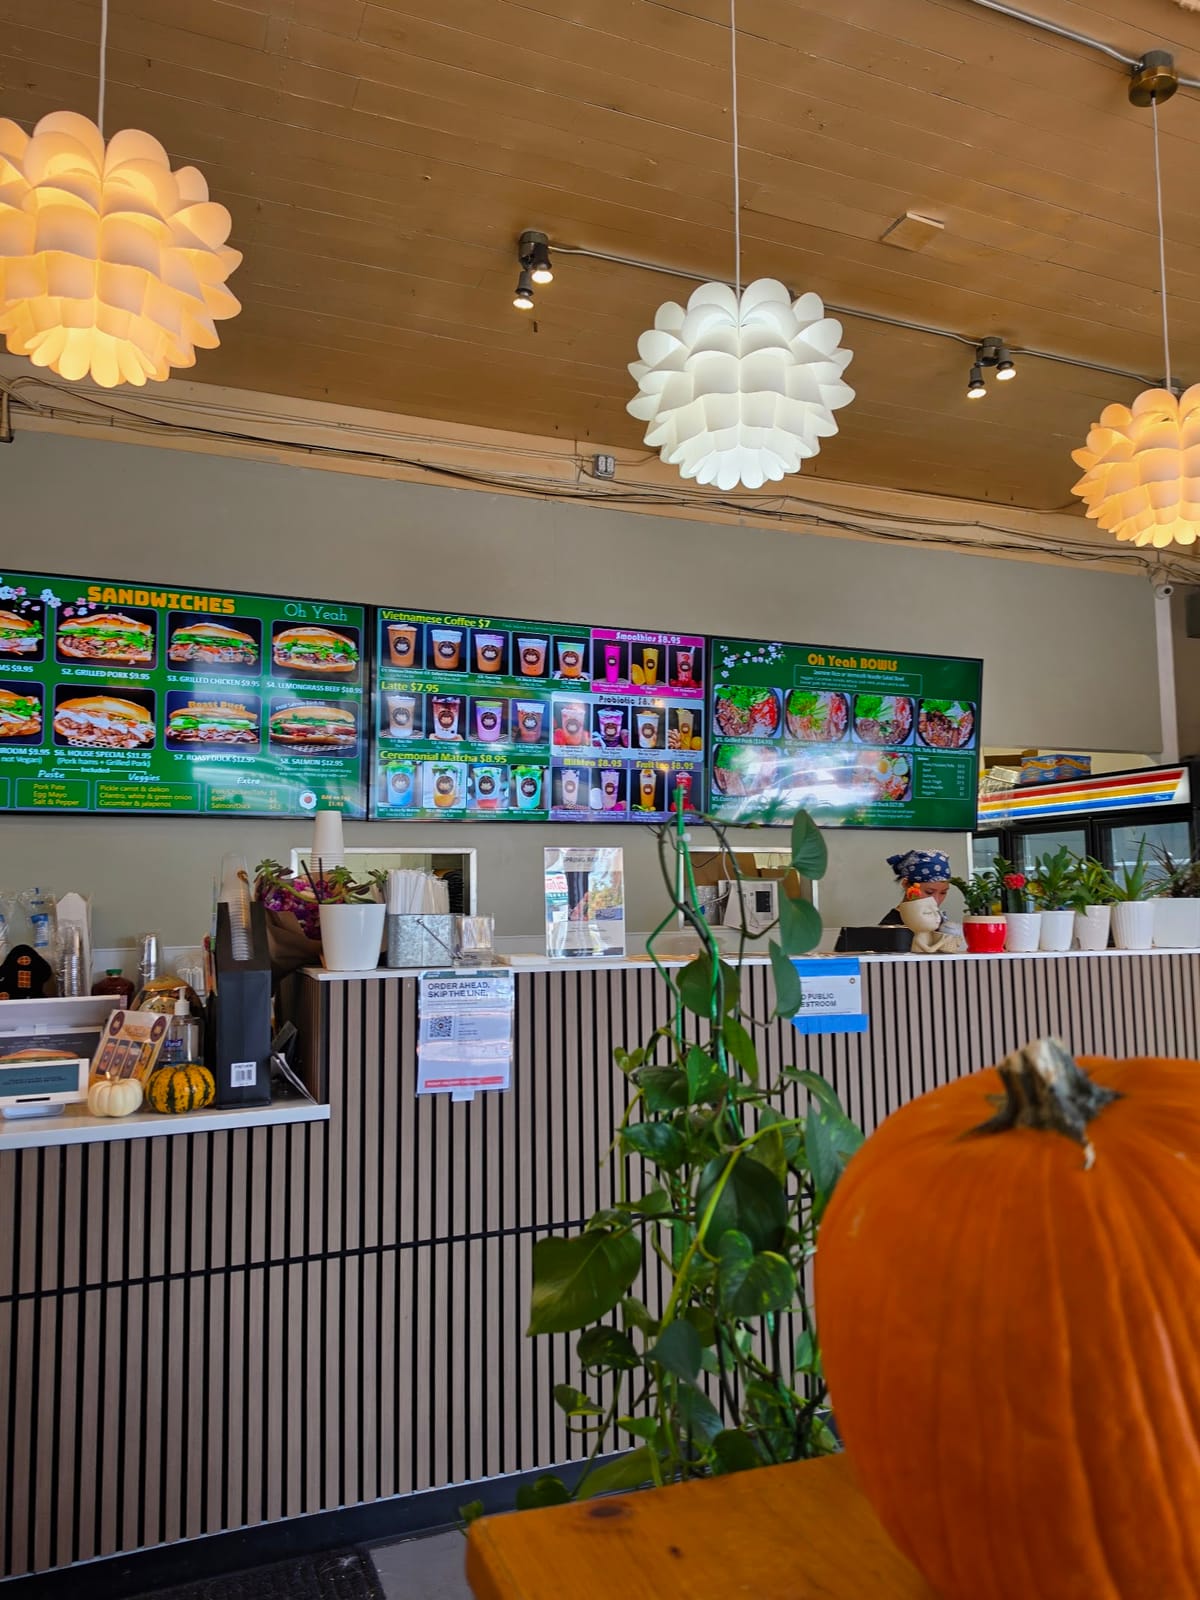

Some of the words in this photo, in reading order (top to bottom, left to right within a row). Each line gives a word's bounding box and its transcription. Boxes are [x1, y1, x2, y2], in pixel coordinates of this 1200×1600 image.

[88, 586, 235, 614] SANDWICHES
[284, 603, 306, 618] Oh
[312, 606, 348, 622] Yeah
[382, 610, 442, 625] Vietnamese
[444, 616, 477, 628] Coffee
[478, 619, 491, 629] $7
[616, 631, 657, 643] Smoothies
[657, 635, 681, 645] $8.95
[807, 653, 825, 666] Oh
[827, 655, 857, 669] Yeah
[860, 658, 898, 672] BOWLS
[74, 669, 106, 678] GRILLED
[107, 671, 129, 679] PORK
[179, 676, 209, 684] GRILLED
[210, 678, 240, 686] CHICKEN
[240, 680, 260, 688] $9.95
[381, 680, 408, 692] Latte
[410, 682, 440, 693] $7.95
[278, 682, 325, 692] LEMONGRASS
[324, 685, 340, 693] BEEF
[599, 695, 635, 706] Probiotic
[67, 749, 95, 757] HOUSE
[95, 751, 125, 759] SPECIAL
[380, 750, 438, 762] Ceremonial
[440, 753, 478, 763] Matcha
[480, 755, 507, 764] $8.95
[291, 758, 321, 767] SALMON
[598, 758, 622, 768] $8.95
[128, 773, 161, 783] Veggies
[237, 777, 260, 785] Extra
[428, 982, 458, 991] ORDER
[458, 982, 490, 990] AHEAD.
[427, 990, 448, 998] SKIP
[448, 990, 466, 998] THE
[466, 989, 489, 997] LINE.
[808, 992, 834, 1000] PUBLIC
[800, 1000, 837, 1008] ESTROOM
